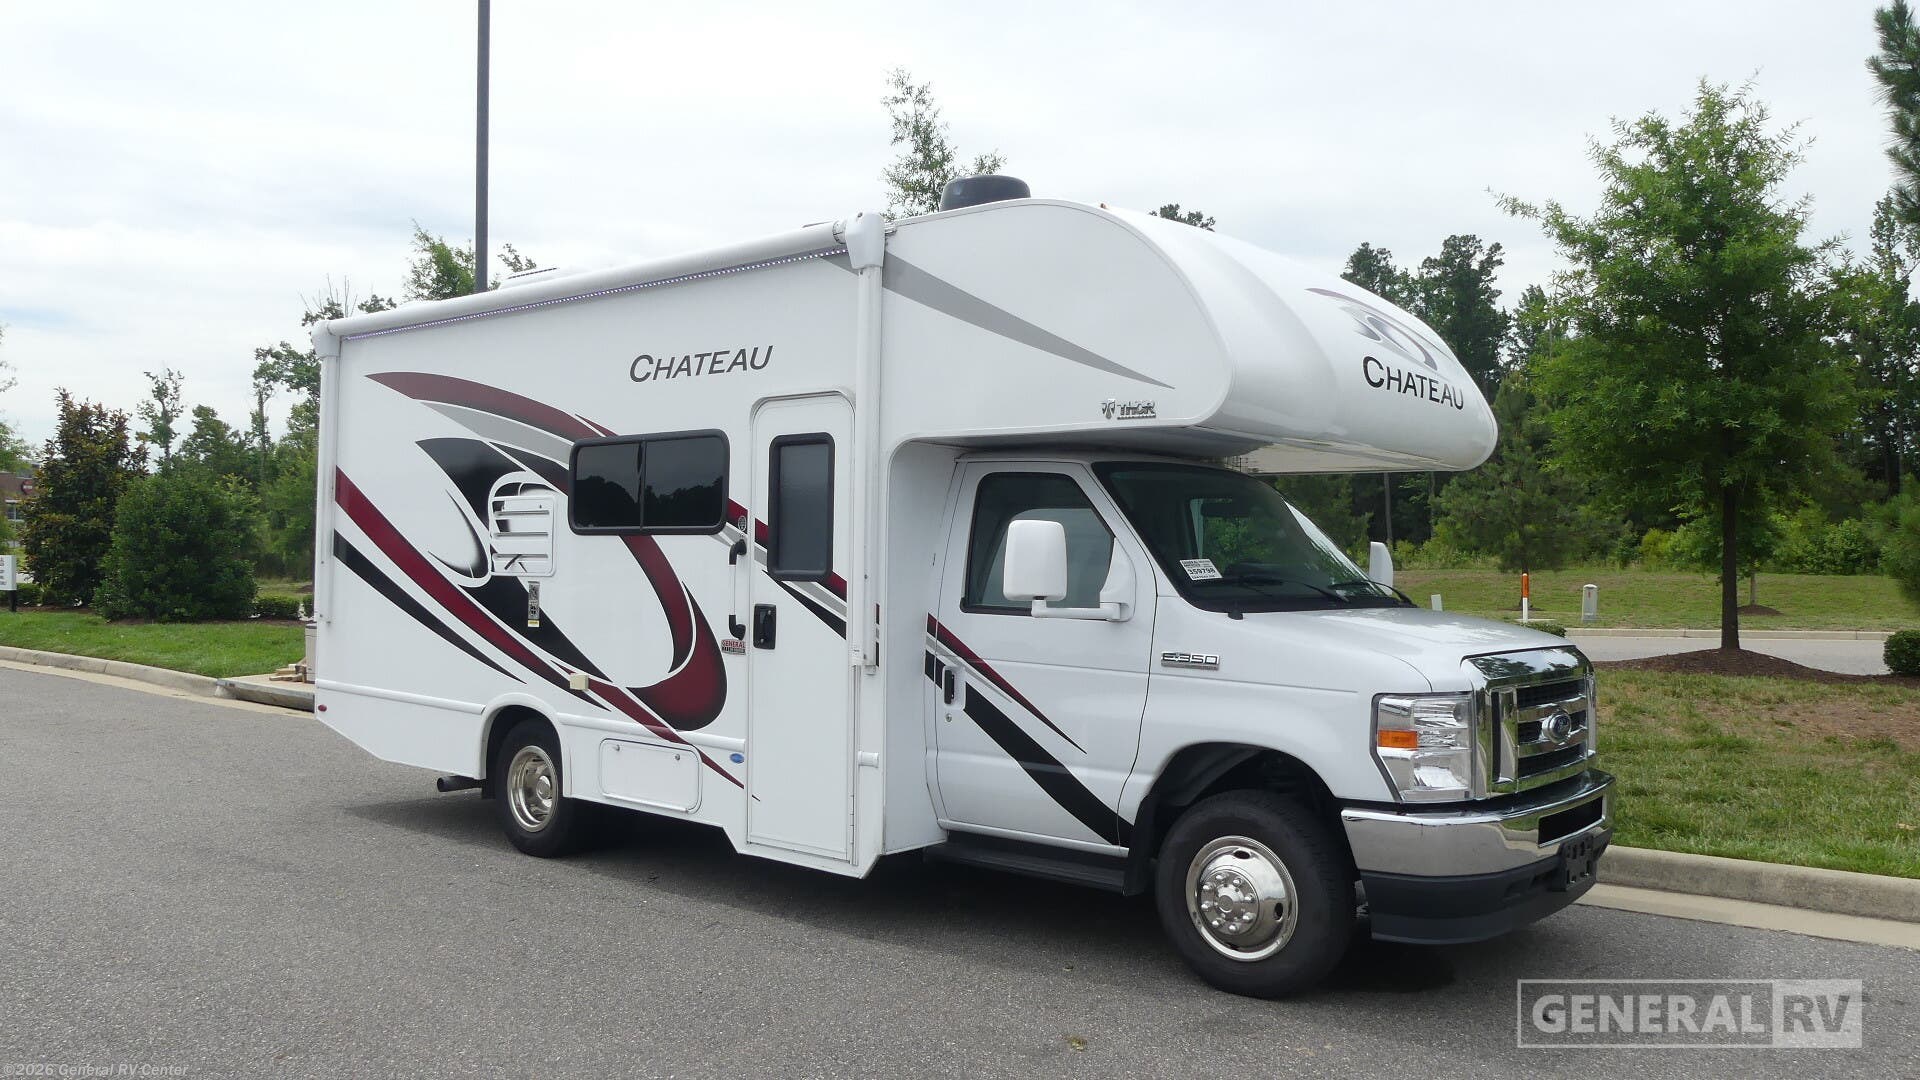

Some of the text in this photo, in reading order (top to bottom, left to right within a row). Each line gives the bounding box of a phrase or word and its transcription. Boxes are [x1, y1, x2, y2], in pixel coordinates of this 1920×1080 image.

[629, 345, 774, 383] CHATEAU
[1362, 355, 1464, 411] CHATEAU
[1116, 400, 1156, 416] THOR
